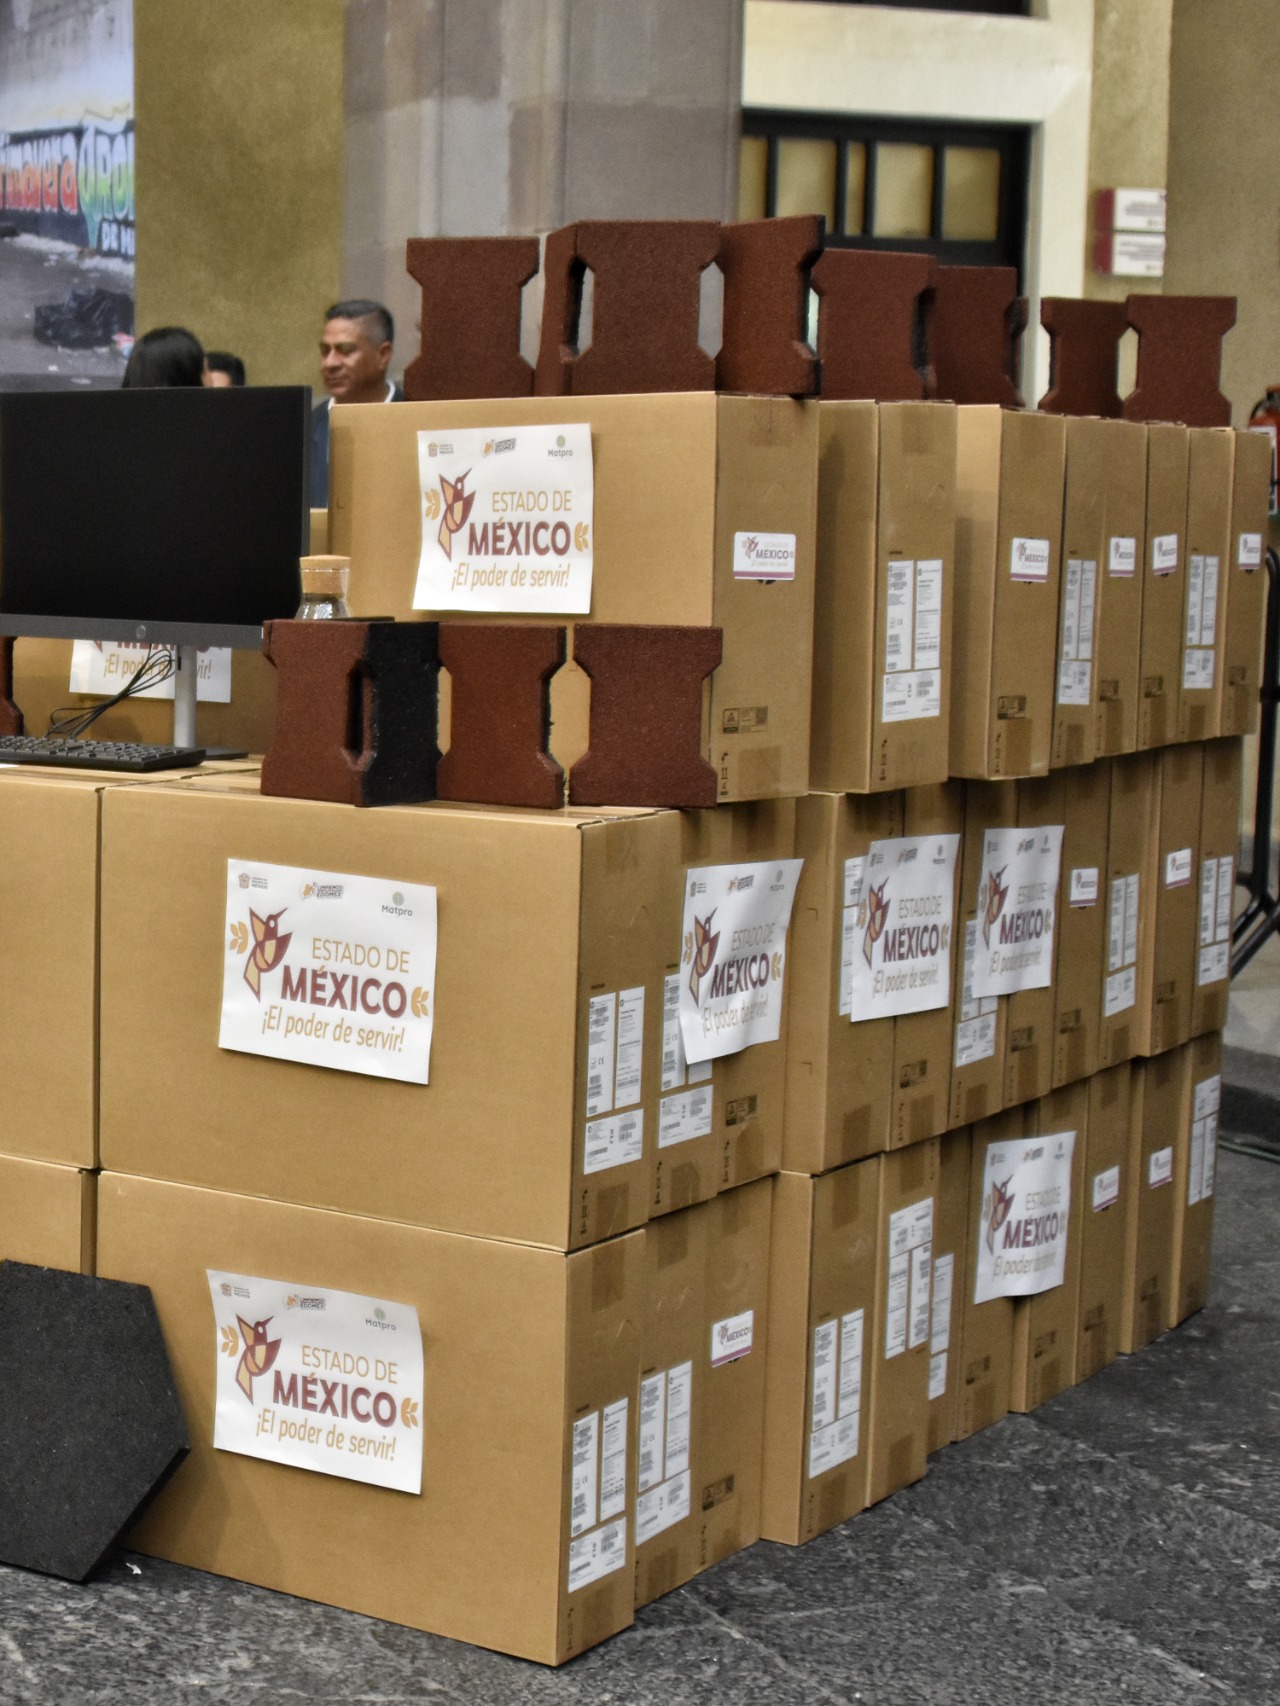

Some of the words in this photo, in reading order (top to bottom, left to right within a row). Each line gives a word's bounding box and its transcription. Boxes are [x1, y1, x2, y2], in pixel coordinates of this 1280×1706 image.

[548, 449, 573, 458] Matpro
[492, 491, 548, 512] ESTADO
[553, 490, 572, 511] DE
[468, 517, 571, 556] MÉXICO
[452, 562, 468, 591] ¡El
[471, 563, 507, 592] poder
[511, 563, 526, 586] de
[530, 563, 570, 587] servir!
[381, 905, 413, 917] Matpro
[312, 937, 381, 968] ESTADO
[386, 949, 410, 974] DE
[883, 923, 939, 963] MÉXICO
[280, 964, 407, 1019] MÉXICO
[710, 952, 769, 1000] MÉXICO
[262, 1005, 283, 1034] ¡El
[285, 1012, 329, 1038] poder
[333, 1017, 352, 1043] de
[357, 1026, 405, 1052] servir!
[1002, 1212, 1058, 1249] MÉXICO
[365, 1318, 396, 1331] Matpro
[302, 1344, 369, 1378] ESTADO
[375, 1359, 397, 1384] DE
[273, 1370, 397, 1428] MÉXICO
[256, 1408, 274, 1437] ¡El
[279, 1417, 322, 1445] poder
[325, 1424, 344, 1450] de
[349, 1436, 396, 1461] servir!
